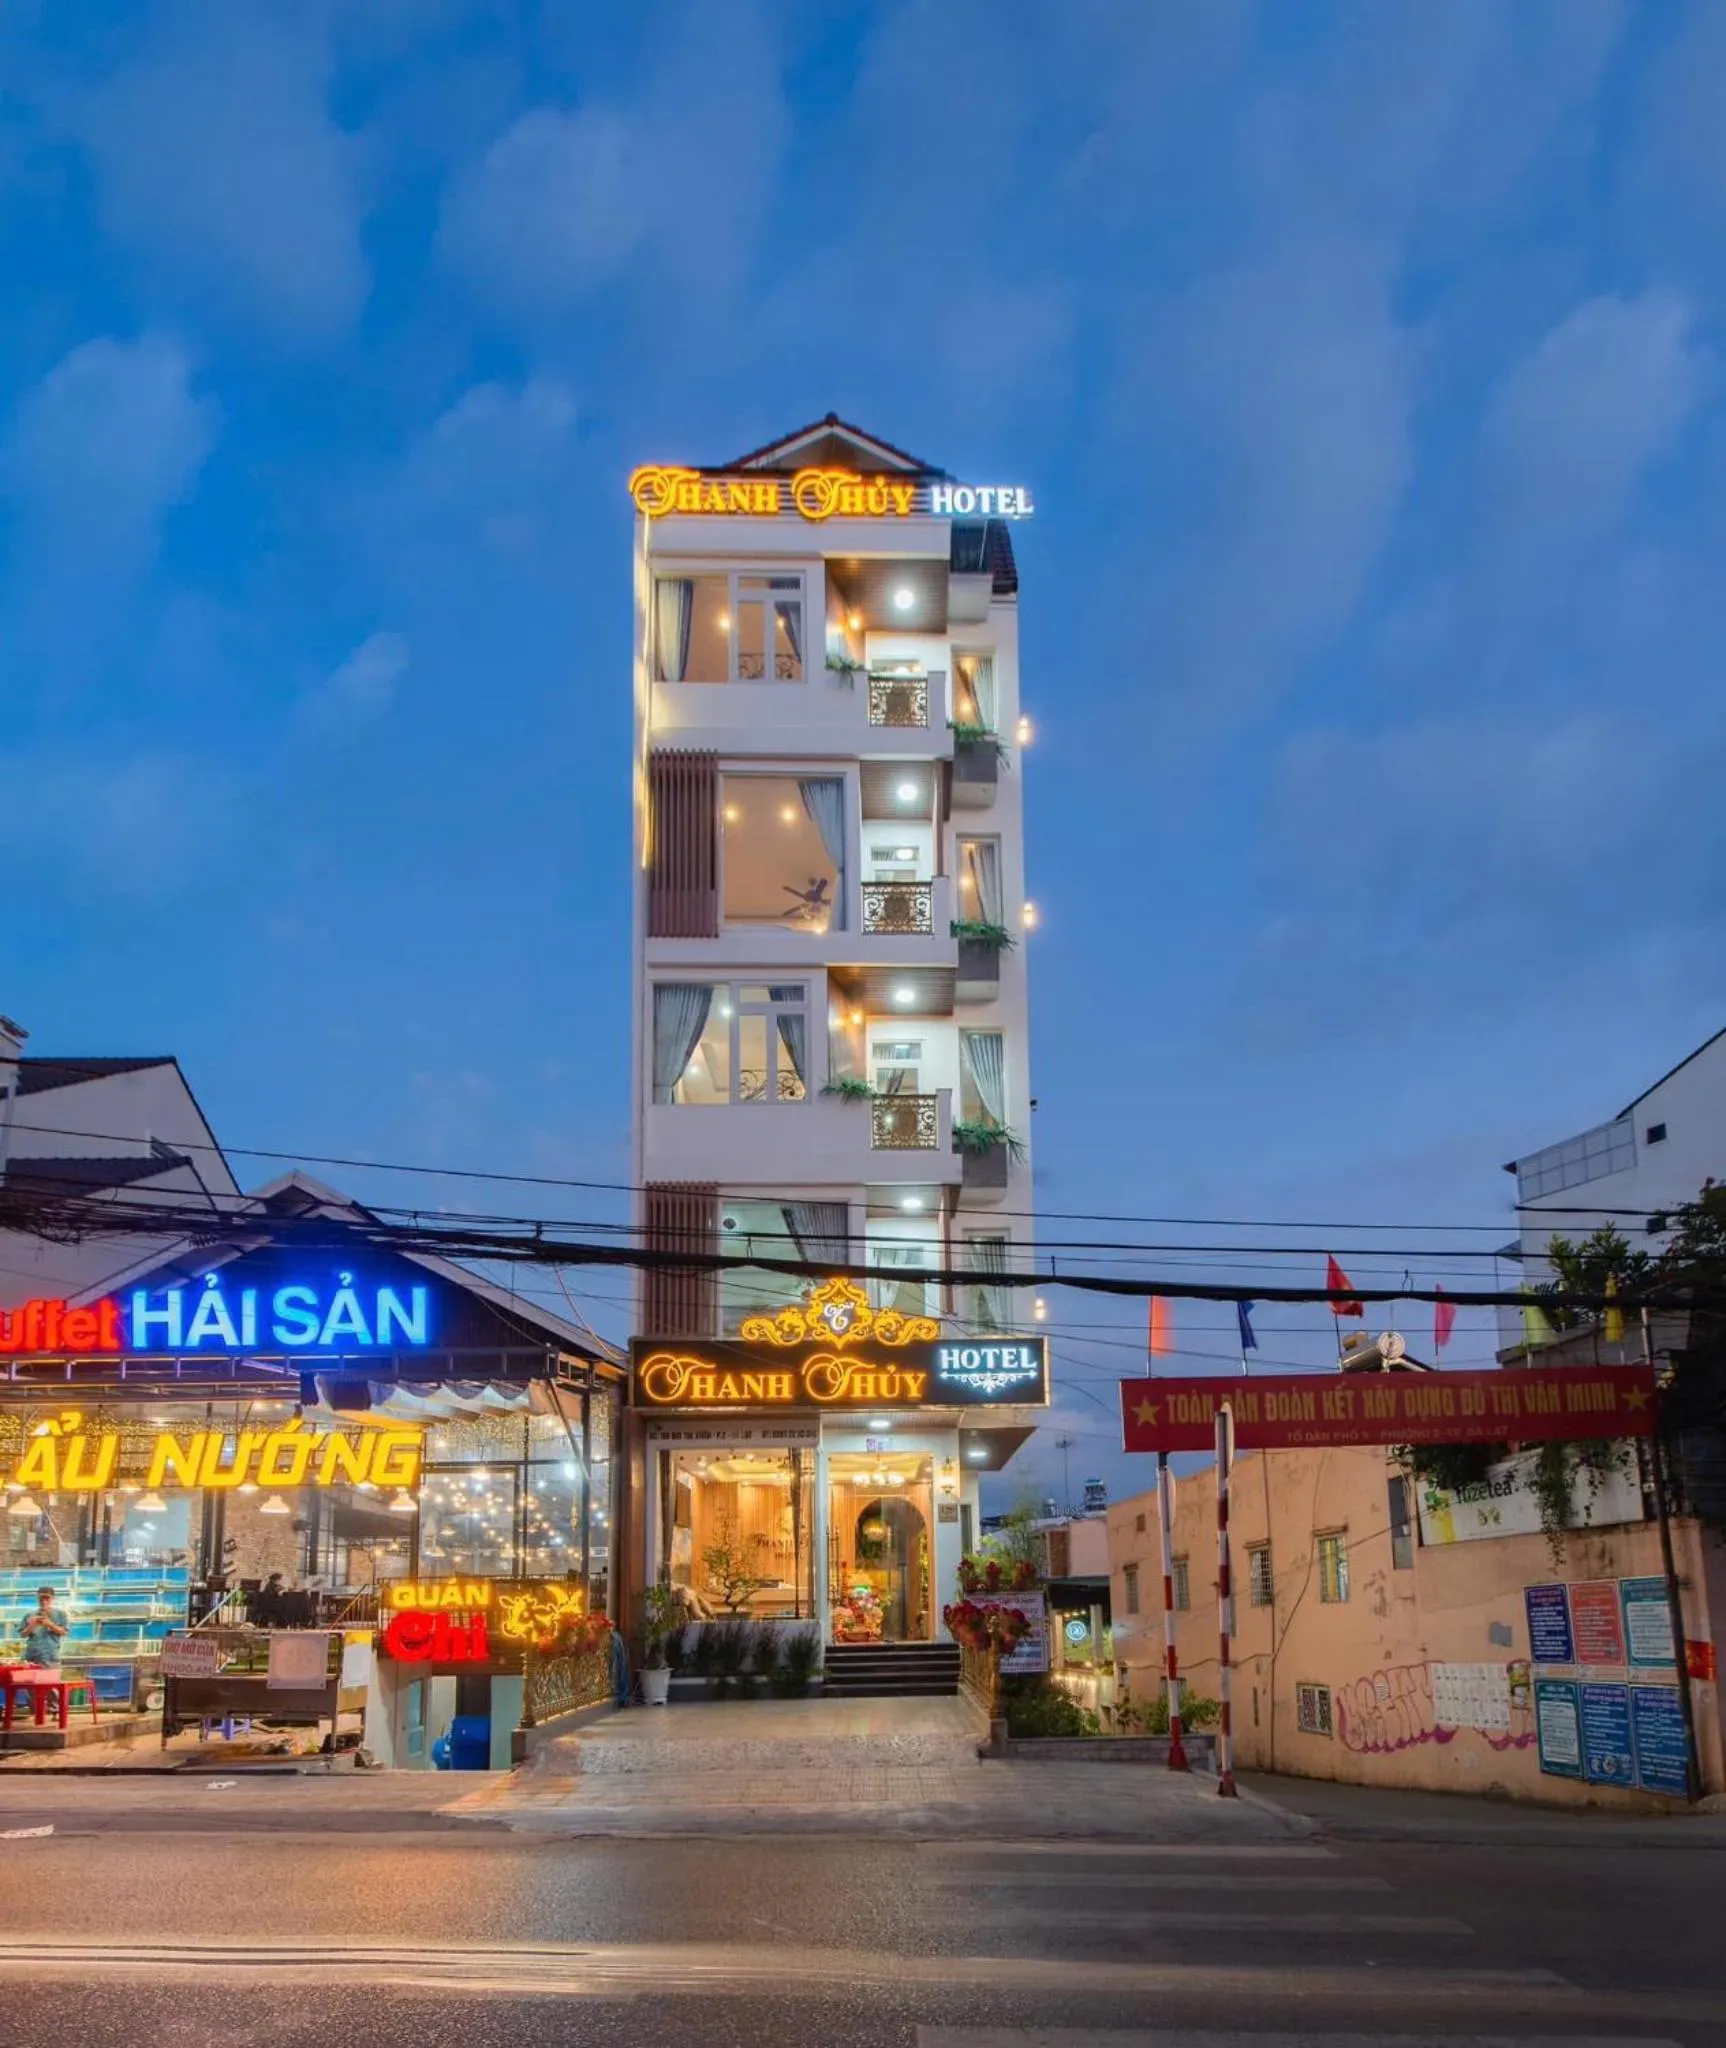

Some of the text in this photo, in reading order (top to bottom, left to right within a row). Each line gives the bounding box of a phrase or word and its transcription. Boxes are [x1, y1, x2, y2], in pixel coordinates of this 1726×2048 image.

[930, 483, 1034, 516] HOTEL
[132, 1272, 257, 1347] HẢI
[272, 1271, 427, 1346] SẢN
[939, 1347, 1038, 1370] HOTEL
[1165, 1388, 1213, 1425] TOÀN
[1264, 1386, 1316, 1423] ĐOÀN
[1322, 1380, 1355, 1421] KẾT
[1403, 1385, 1452, 1421] DỰNG
[1489, 1384, 1521, 1418] THỊ
[1523, 1379, 1561, 1413] VĂN
[1565, 1380, 1617, 1412] MINH
[0, 1411, 423, 1490] ẨU NƯỚNG
[391, 1577, 490, 1607] QUÁN
[384, 1611, 489, 1662] Chi
